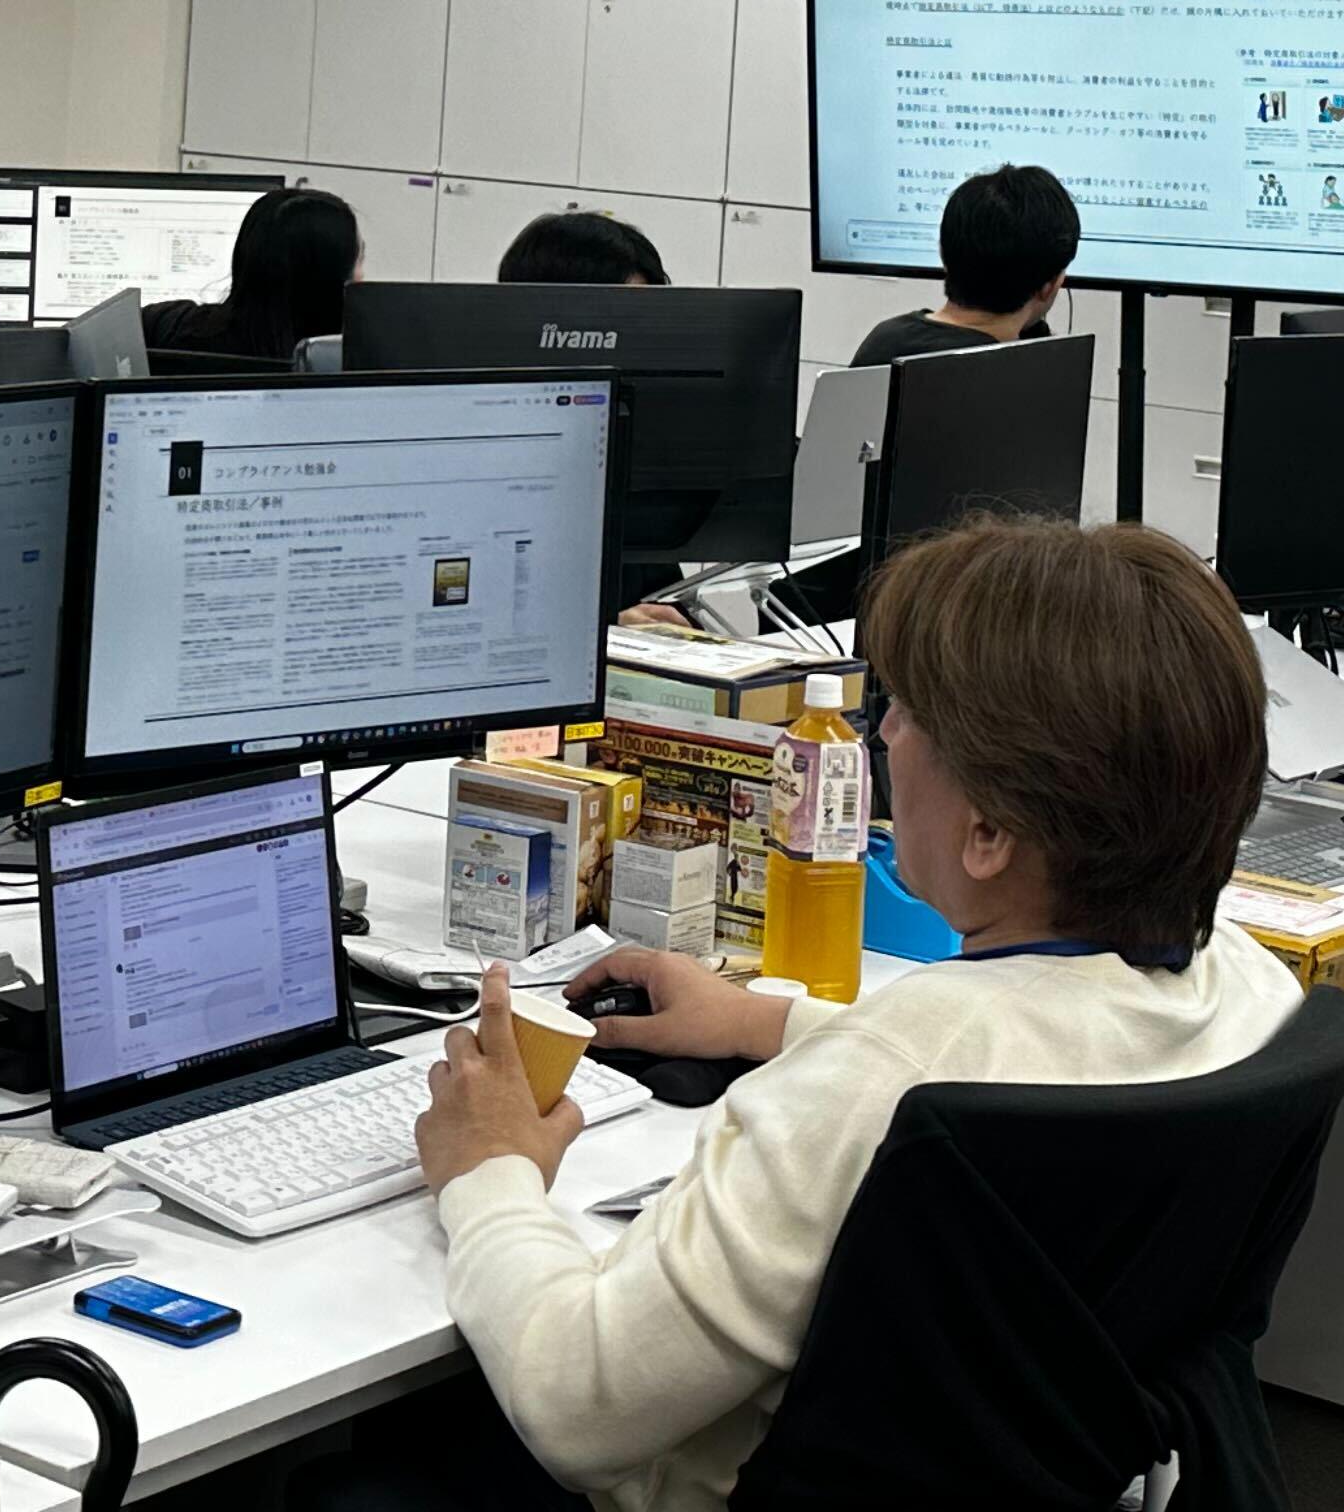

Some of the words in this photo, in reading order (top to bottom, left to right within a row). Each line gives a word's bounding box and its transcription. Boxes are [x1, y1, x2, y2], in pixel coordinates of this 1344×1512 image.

[539, 323, 618, 349] iiyama
[178, 466, 192, 479] 01
[214, 463, 337, 479] コンプライアンス勉強会
[177, 496, 283, 514] 特定商取引法／事例
